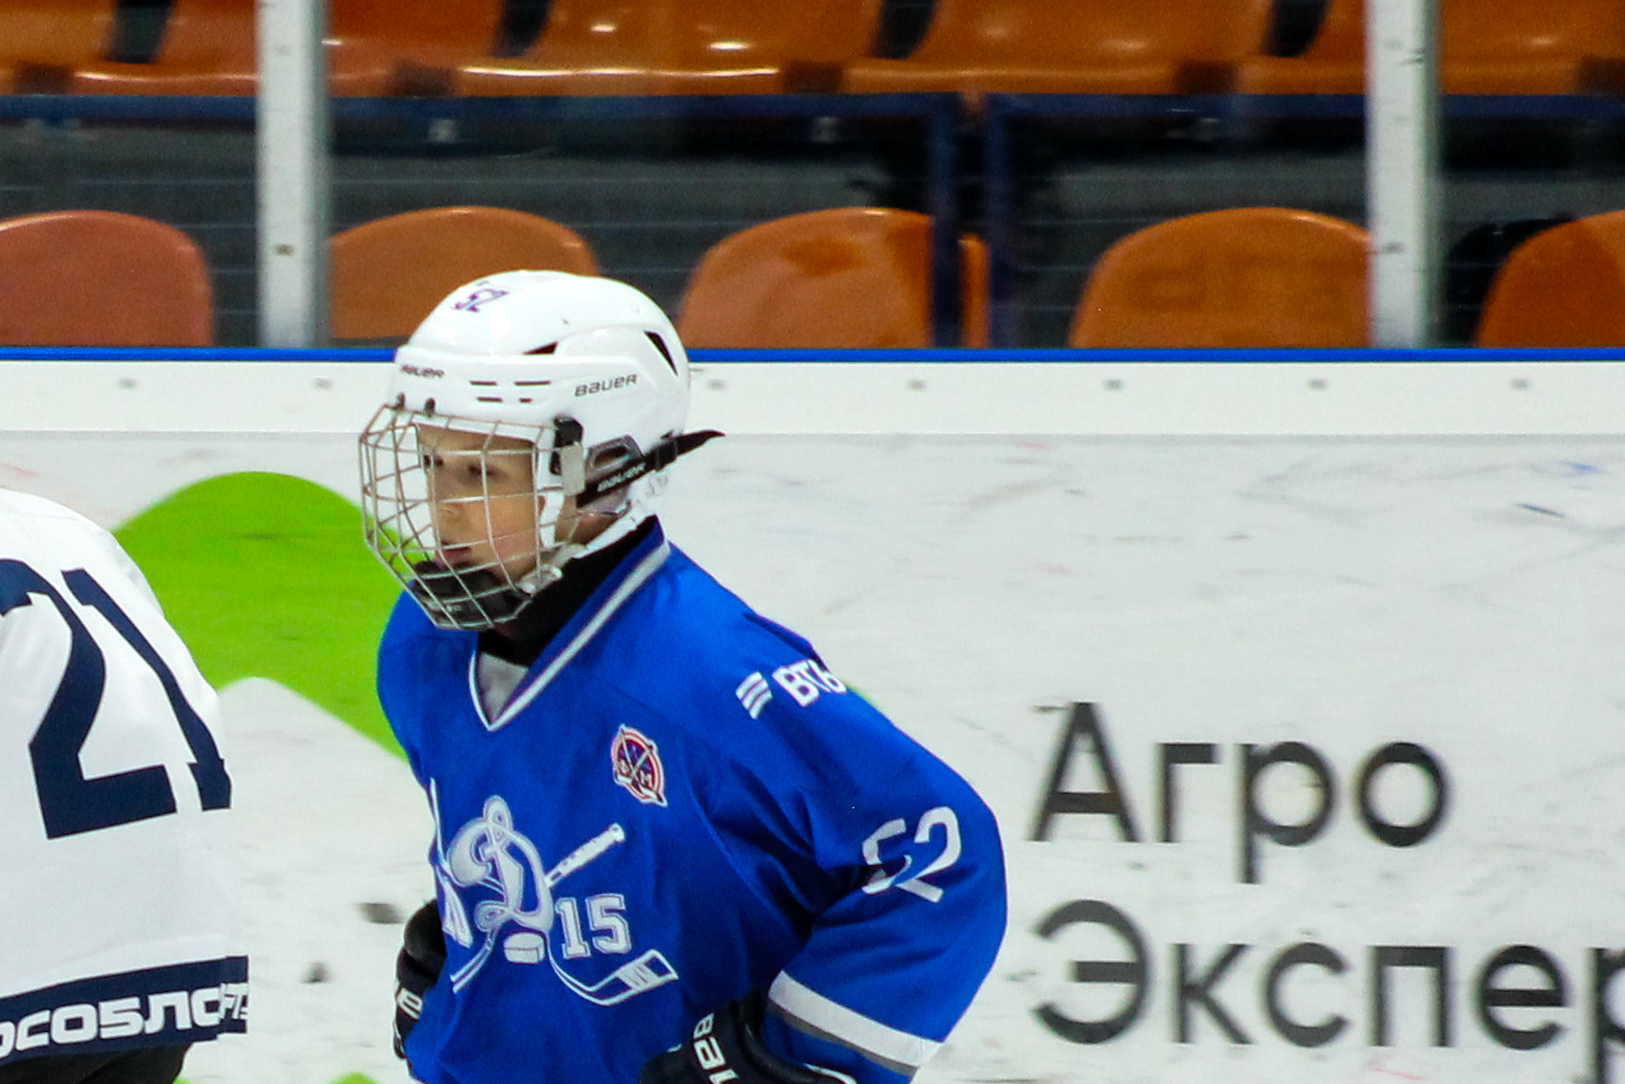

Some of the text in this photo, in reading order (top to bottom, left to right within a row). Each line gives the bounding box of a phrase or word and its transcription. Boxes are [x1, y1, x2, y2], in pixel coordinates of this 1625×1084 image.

[1025, 701, 1452, 884] Агро
[862, 806, 961, 903] 52
[555, 894, 632, 959] 15
